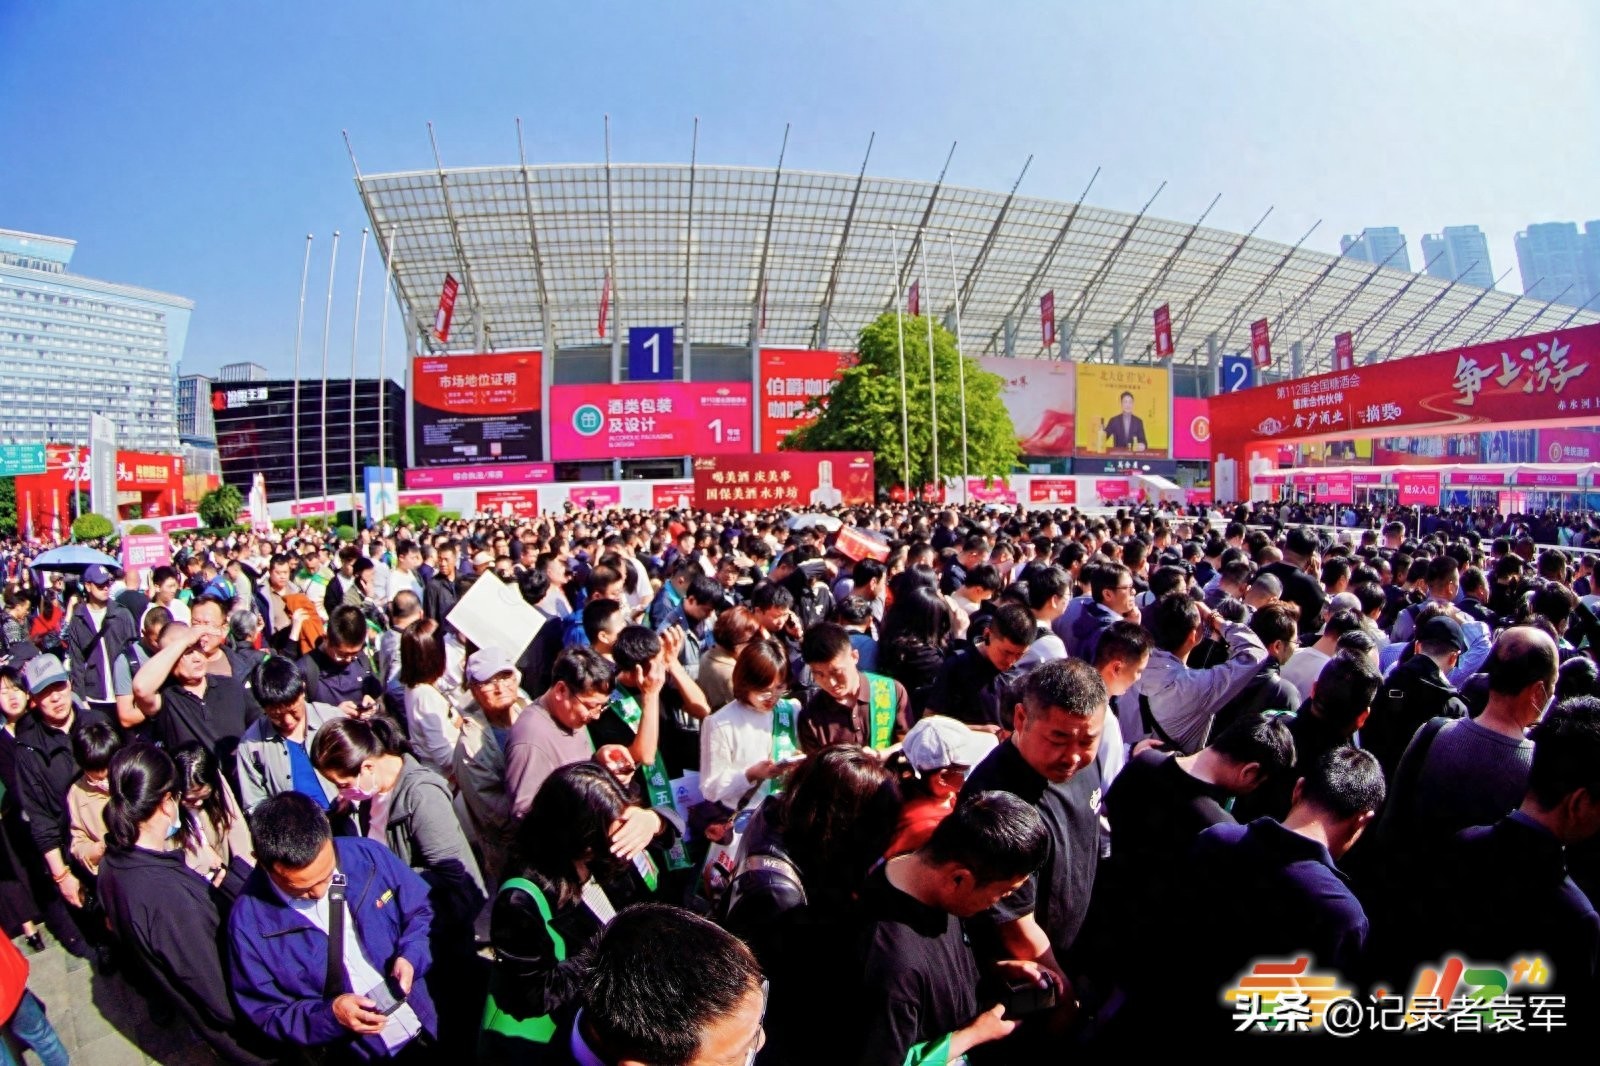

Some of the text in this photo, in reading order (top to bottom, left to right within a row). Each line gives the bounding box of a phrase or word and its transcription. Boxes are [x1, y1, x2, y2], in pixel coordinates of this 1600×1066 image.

[643, 333, 659, 373] 1
[1231, 362, 1247, 392] 2
[1452, 337, 1589, 405] 争上游
[440, 372, 517, 388] 市场地位证明
[1276, 373, 1360, 399] 第112届全国糖酒会
[608, 398, 672, 414] 酒类包装
[608, 417, 656, 433] 及设计
[708, 419, 722, 443] 1
[712, 470, 749, 483] 喝美酒
[706, 487, 798, 500] 国保美酒 水井坊
[1403, 485, 1436, 495] 观众入口
